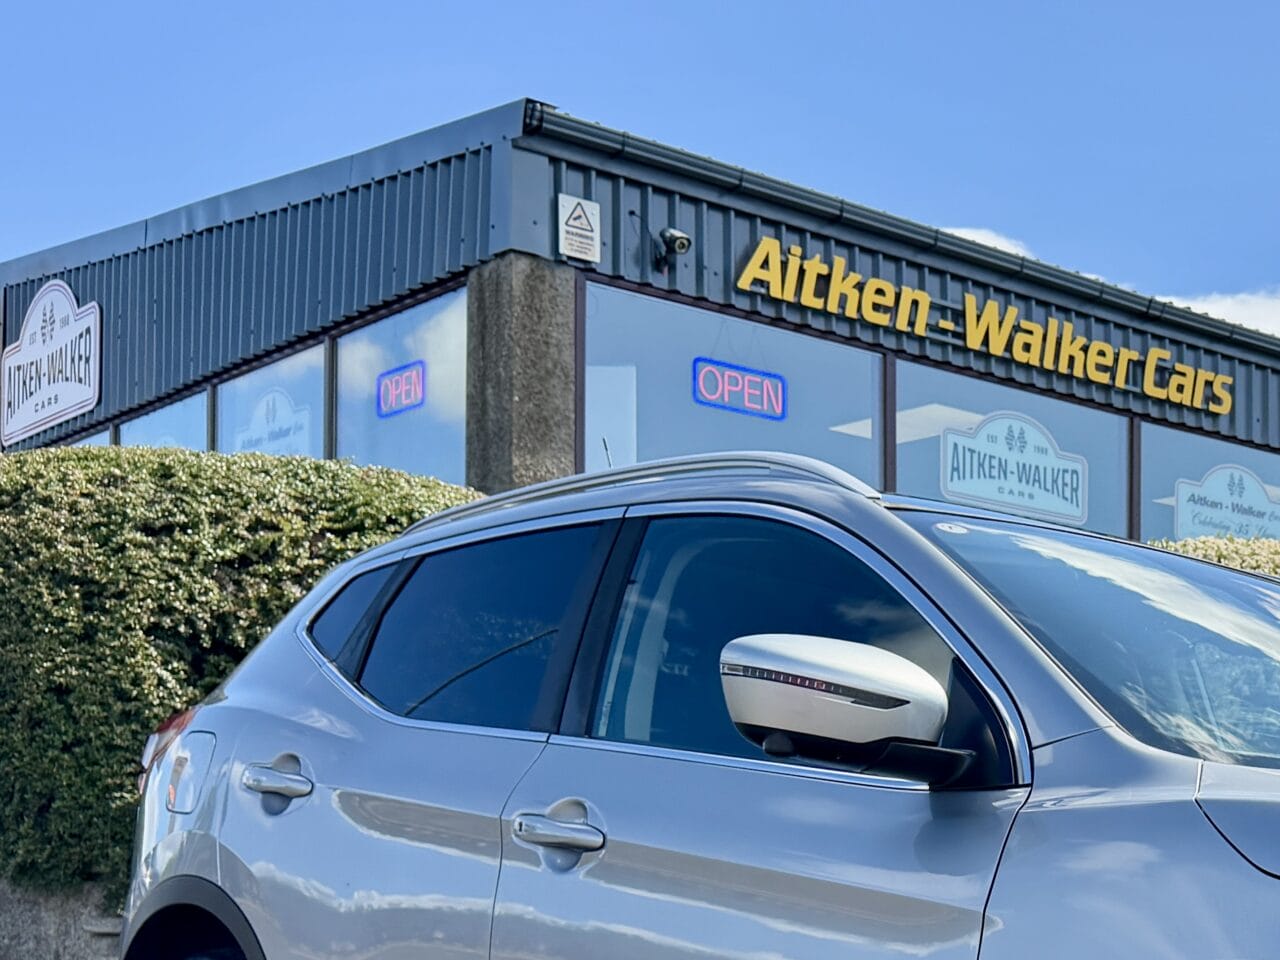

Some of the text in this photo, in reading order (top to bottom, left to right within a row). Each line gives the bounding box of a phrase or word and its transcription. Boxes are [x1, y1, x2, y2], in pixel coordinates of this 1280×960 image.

[736, 235, 931, 337] Aitken
[964, 292, 1140, 389] Walker
[1142, 347, 1234, 415] Cars
[6, 325, 92, 424] AITKEN-WALKER
[380, 367, 423, 412] OPEN
[698, 364, 784, 415] OPEN
[34, 394, 59, 413] CARS
[950, 441, 1080, 509] AITKEN-WALKER
[997, 485, 1035, 500] CARS
